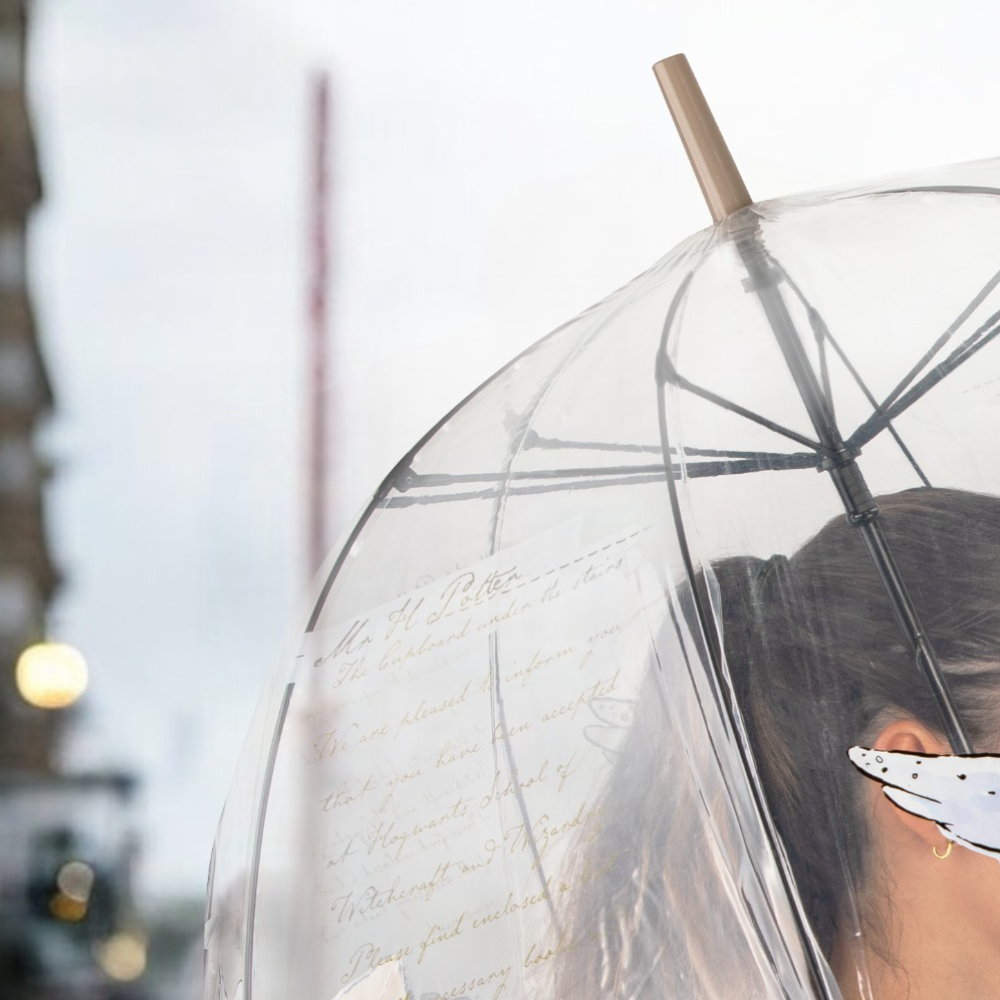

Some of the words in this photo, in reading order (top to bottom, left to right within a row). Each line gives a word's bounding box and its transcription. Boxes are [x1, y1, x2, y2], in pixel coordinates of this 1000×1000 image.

[313, 617, 374, 669] Mr
[427, 565, 523, 626] Potter
[333, 656, 368, 690] The
[377, 617, 473, 672] Cupboard
[476, 597, 533, 632] under
[540, 577, 564, 603] the
[572, 556, 624, 591] stairs
[313, 722, 361, 761] We
[393, 679, 472, 740] pleased
[505, 648, 577, 688] inform
[577, 623, 624, 672] you
[319, 773, 380, 813] that
[378, 768, 426, 814] you
[434, 740, 483, 769] have
[541, 666, 622, 721] accepted
[331, 859, 464, 925] Witchcraft
[461, 838, 503, 874] and
[366, 796, 476, 861] Hogwarts
[341, 942, 413, 985] Please
[416, 910, 464, 966] find
[472, 874, 553, 929] enclosed
